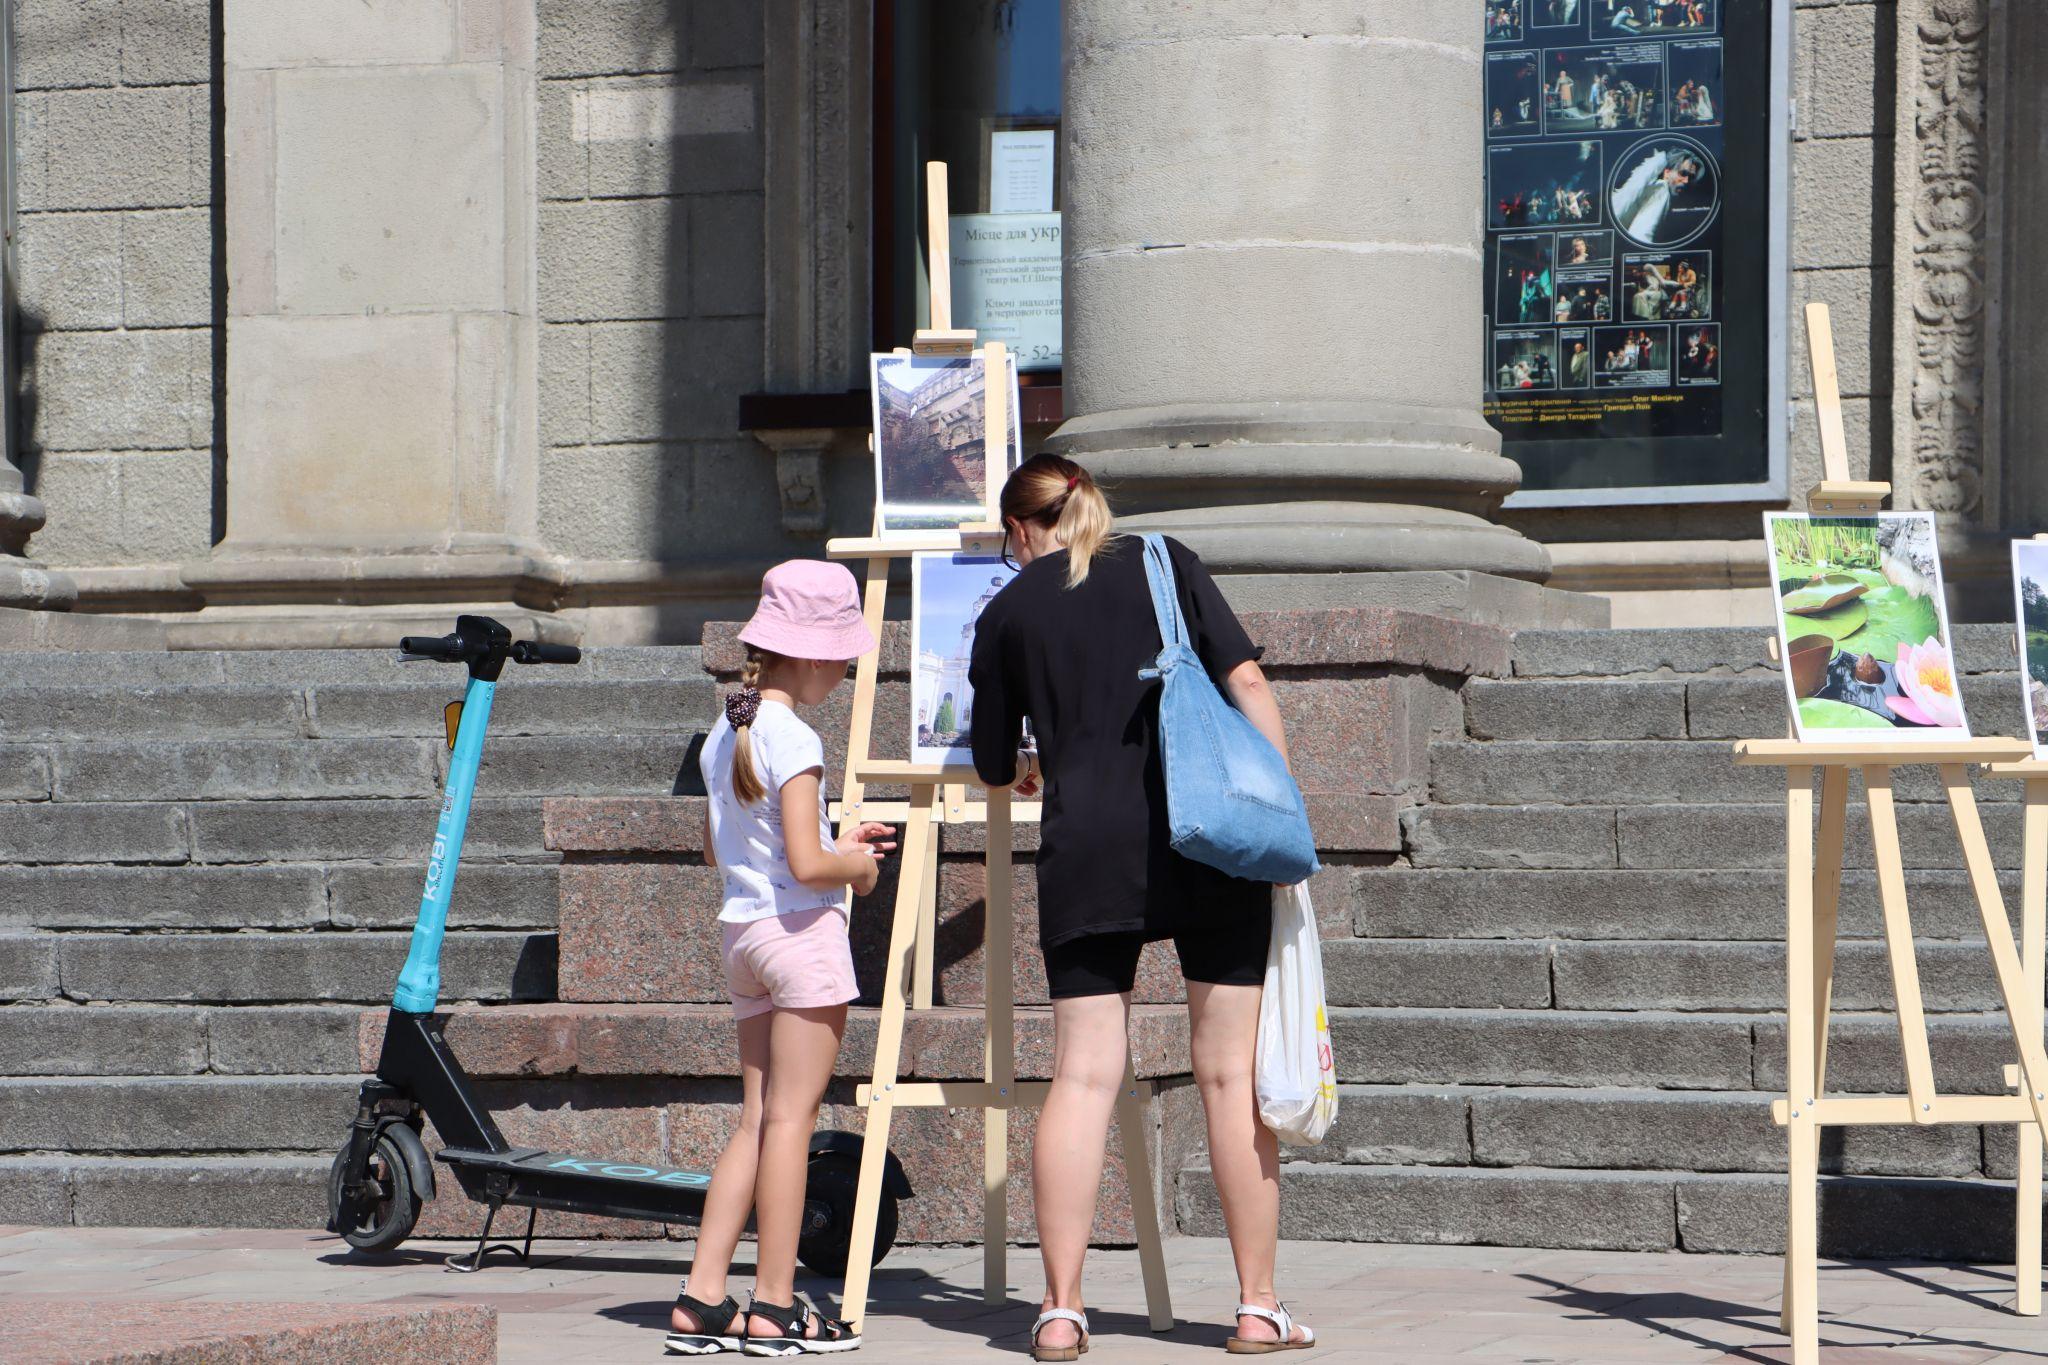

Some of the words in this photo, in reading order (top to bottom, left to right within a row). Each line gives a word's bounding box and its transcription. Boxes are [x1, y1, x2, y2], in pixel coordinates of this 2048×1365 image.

[965, 229, 1003, 241] Місце
[1006, 230, 1027, 240] для
[985, 298, 1015, 308] Ключі
[995, 308, 1042, 319] чергового
[423, 833, 447, 900] KOBI
[547, 1158, 712, 1184] KOB
